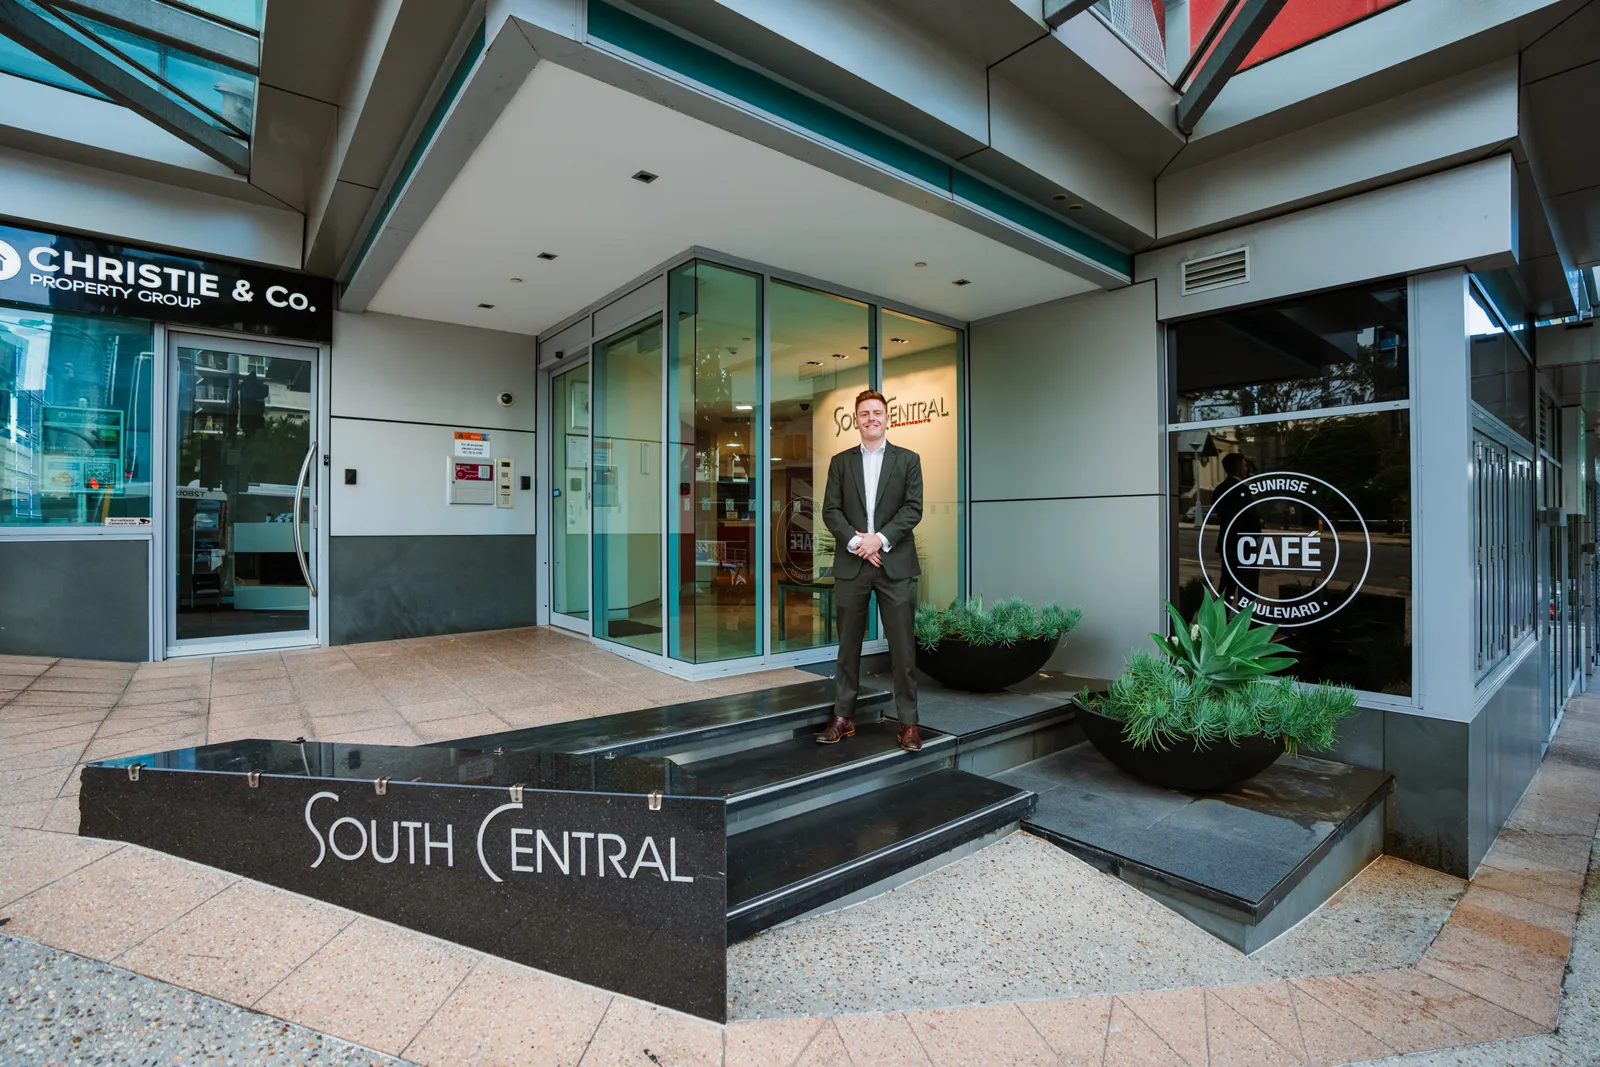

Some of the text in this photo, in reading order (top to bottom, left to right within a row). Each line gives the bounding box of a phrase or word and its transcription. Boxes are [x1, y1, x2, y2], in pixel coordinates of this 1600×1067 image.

[28, 246, 220, 298] CHRISTIE
[232, 279, 255, 303] &
[29, 273, 201, 309] PROPERTY GROUP
[833, 406, 859, 437] SOU
[890, 417, 932, 428] APARTMENTS
[1248, 478, 1309, 495] SUNRISE
[1236, 530, 1322, 567] CAFÉ
